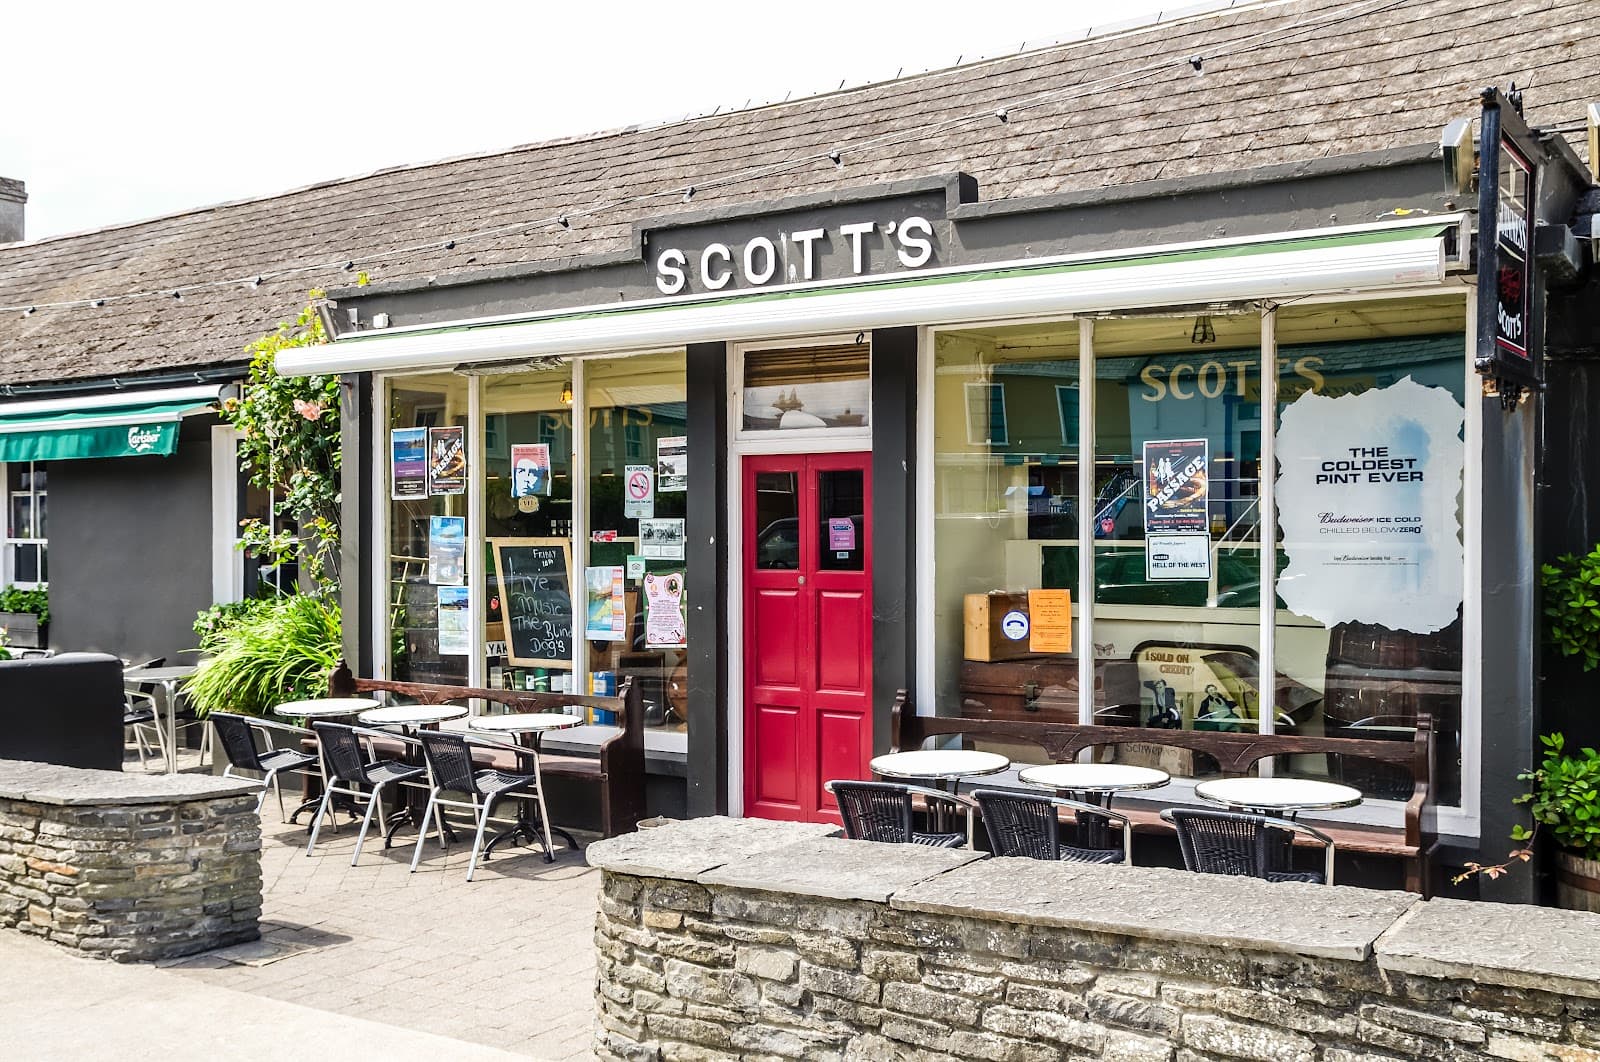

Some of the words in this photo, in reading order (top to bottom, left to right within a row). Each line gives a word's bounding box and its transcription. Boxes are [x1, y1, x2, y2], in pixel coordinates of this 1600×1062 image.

[655, 216, 933, 295] SCOTT'S
[1348, 446, 1389, 458] THE
[1321, 458, 1417, 472] COLDEST
[1147, 455, 1206, 513] PASSAGE
[1316, 473, 1361, 485] PINT
[1368, 471, 1424, 483] EVER
[1317, 512, 1374, 524] Budweiser
[1319, 526, 1360, 534] CHILLED
[486, 642, 508, 657] YAK
[1150, 652, 1174, 663] SOLD
[1176, 654, 1189, 664] ON
